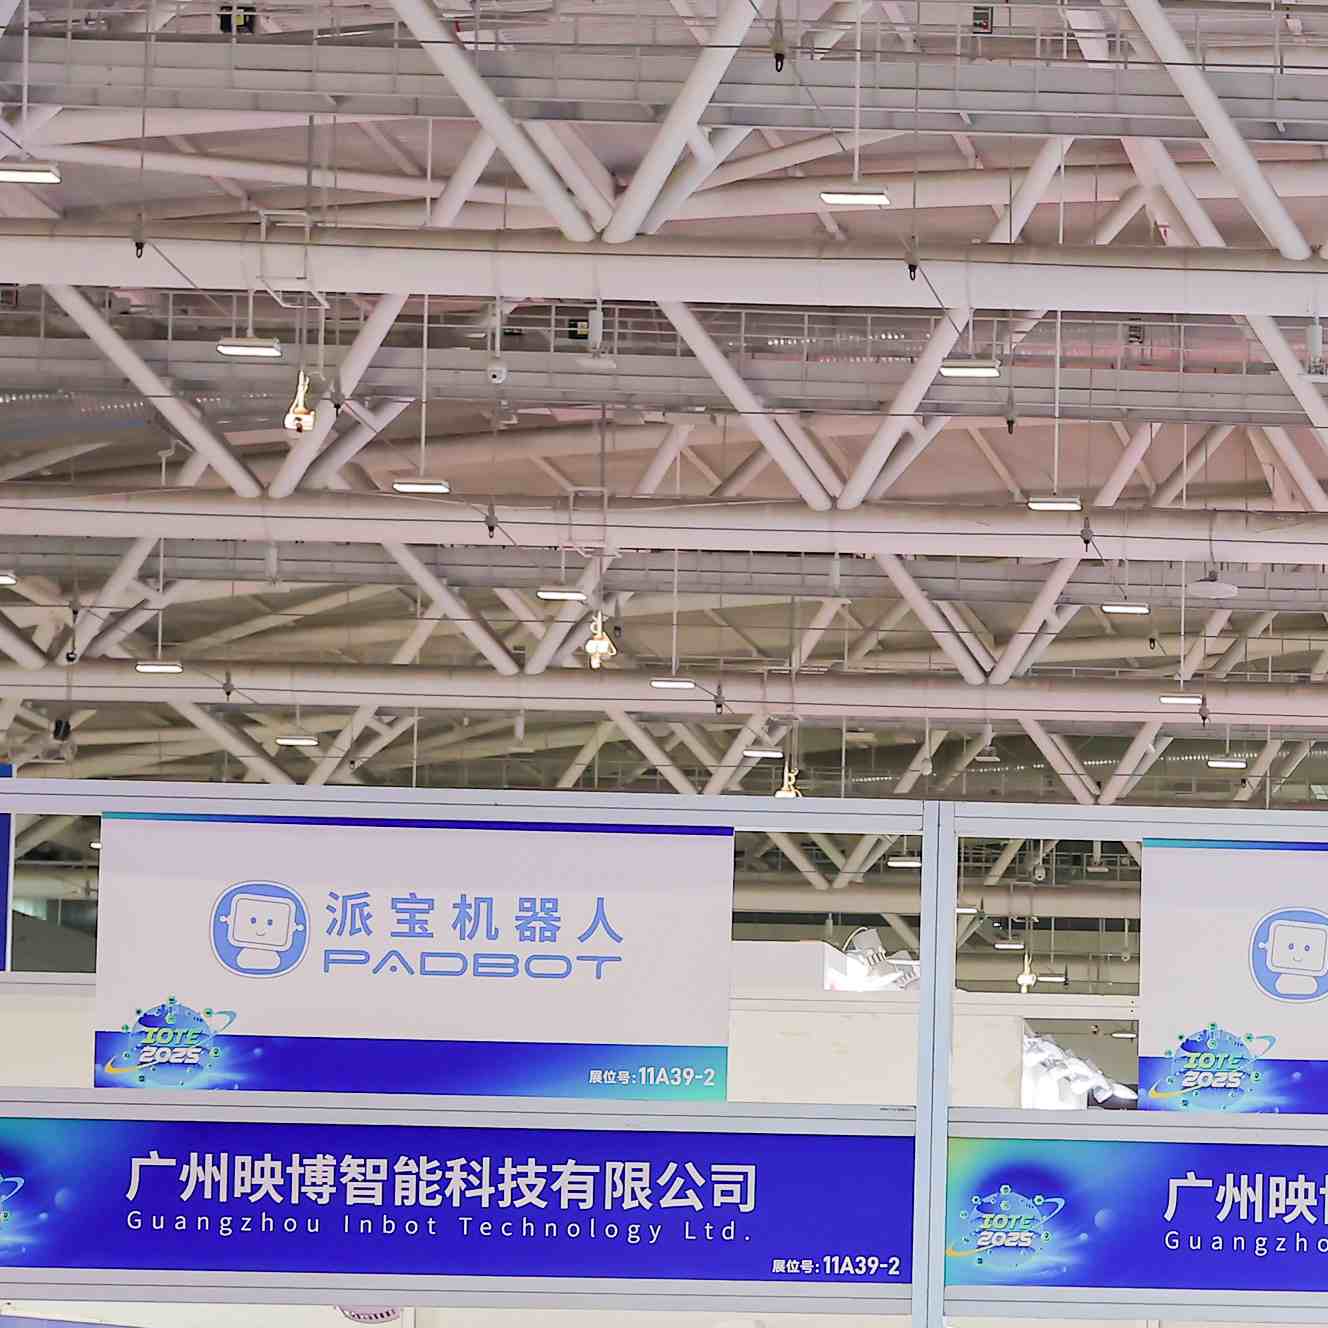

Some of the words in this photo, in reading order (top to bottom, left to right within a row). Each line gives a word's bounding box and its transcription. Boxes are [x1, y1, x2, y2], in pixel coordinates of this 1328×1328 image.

[325, 891, 624, 945] 派宝机器人
[323, 950, 623, 980] PADBOT
[141, 1028, 202, 1047] IOTE
[138, 1047, 203, 1066] 2025
[1184, 1053, 1242, 1071] IOTE
[1181, 1070, 1244, 1089] 2025
[126, 1151, 757, 1214] 广州映博智能科技有限公司
[127, 1210, 321, 1236] Guangzhou
[344, 1215, 439, 1236] Inbot
[460, 1217, 663, 1245] Technology
[685, 1220, 752, 1242] Ltd.
[980, 1214, 1033, 1231] IOTE
[976, 1230, 1034, 1249] 2025
